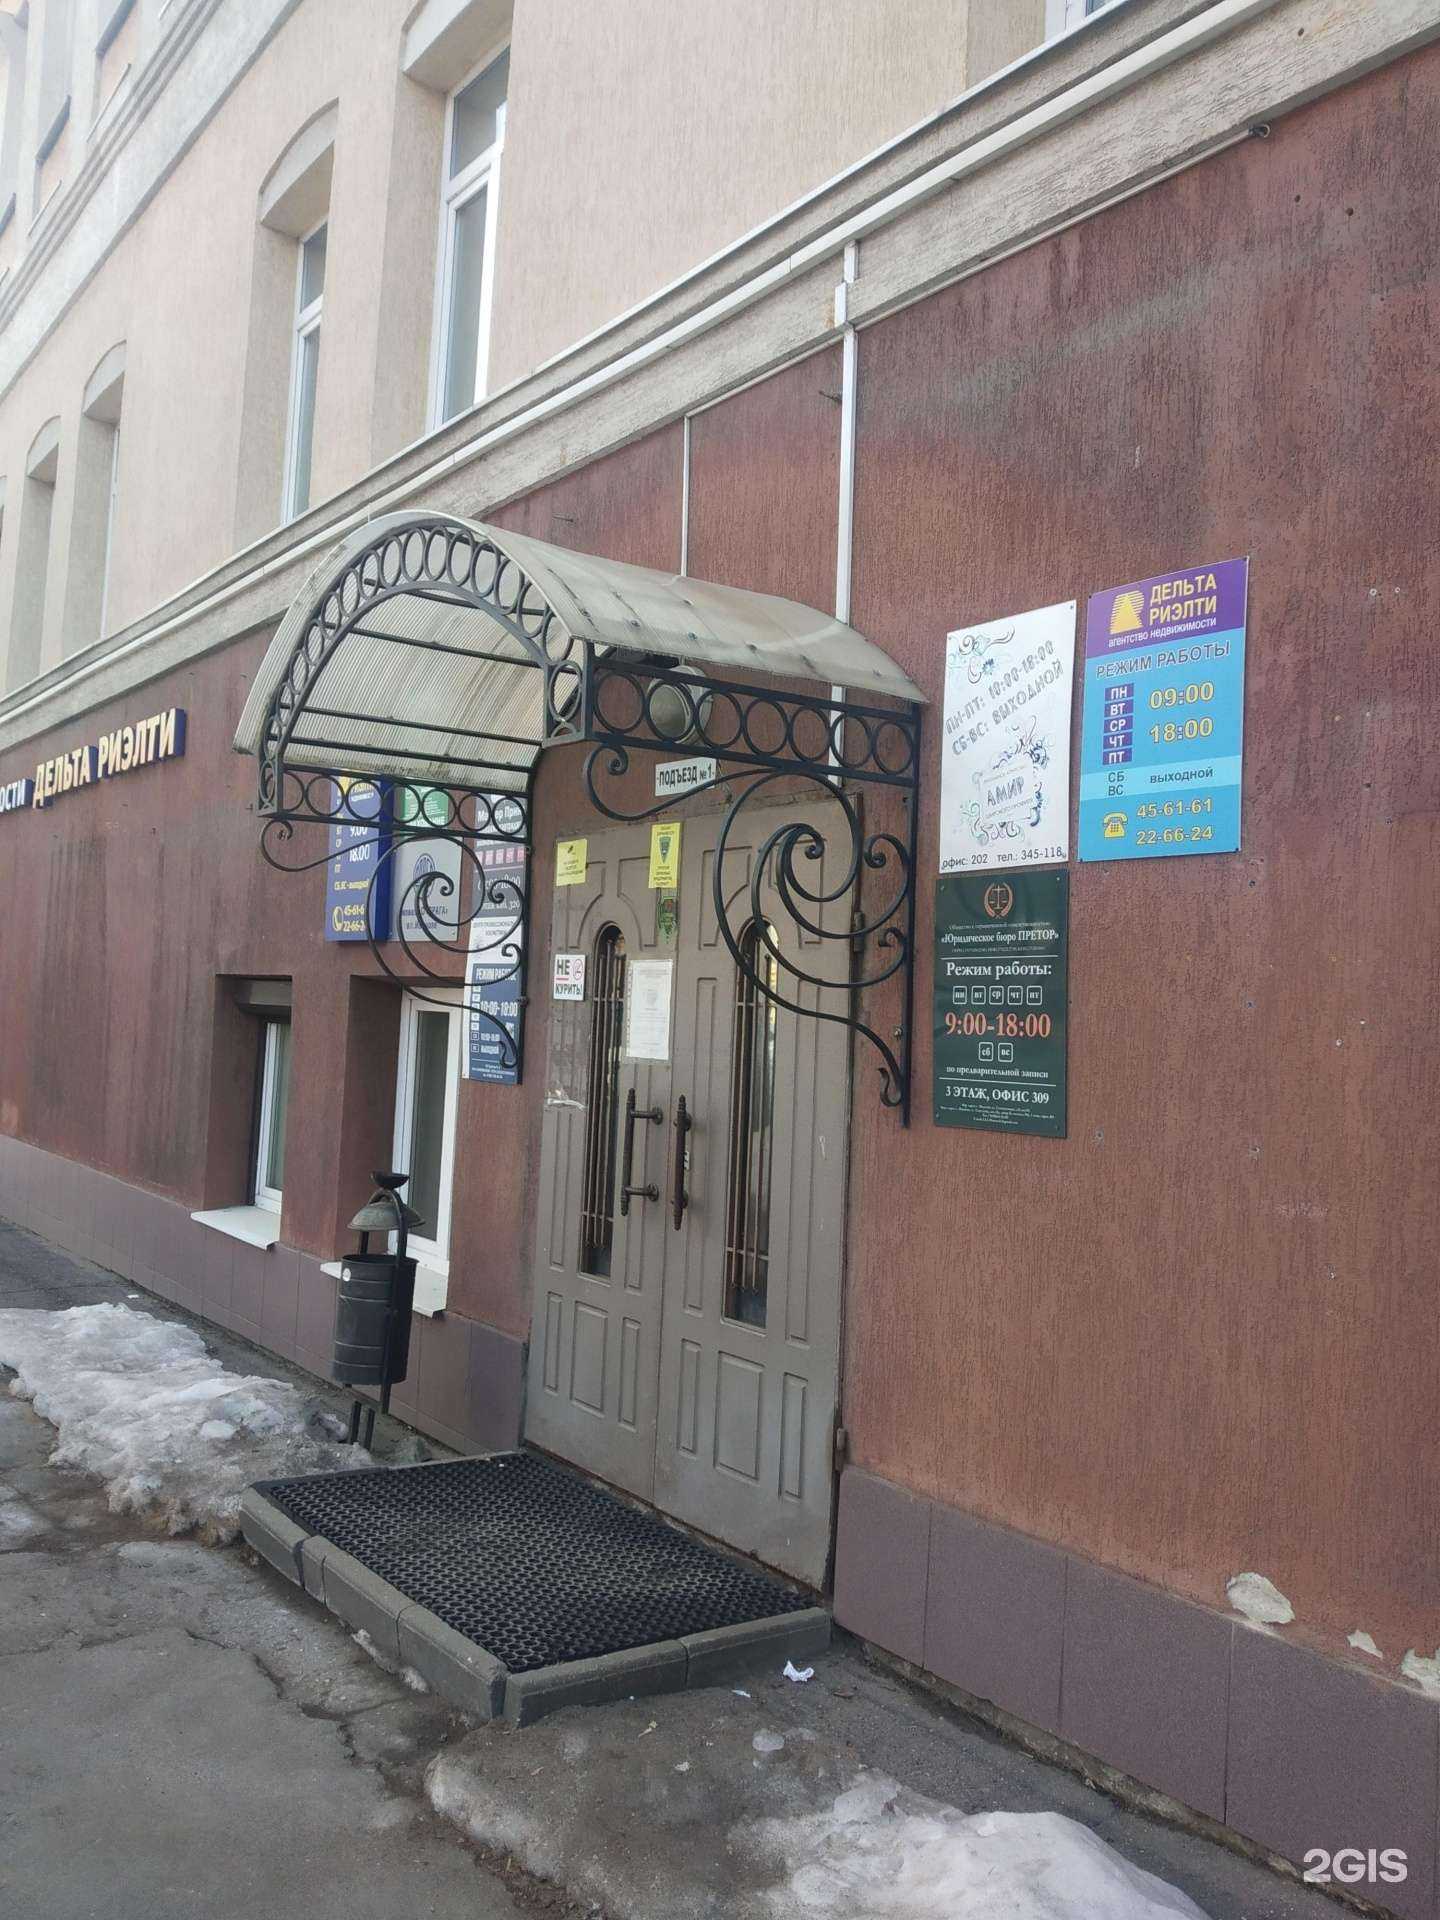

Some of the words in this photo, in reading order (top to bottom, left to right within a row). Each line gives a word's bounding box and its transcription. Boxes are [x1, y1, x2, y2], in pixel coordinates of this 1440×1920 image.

[1150, 573, 1217, 606] ДЕЛЬТА
[1149, 595, 1217, 627] РИЭЛТИ
[1096, 655, 1152, 680] РЕЖИМ
[1156, 639, 1230, 669] РАБОТЫ
[1110, 686, 1128, 699] ПН
[1150, 681, 1214, 709] 09:00
[951, 721, 990, 756] СБ-ВС:
[991, 658, 1064, 725] ВЫХОДНОЙ
[1110, 702, 1126, 715] ВТ
[1109, 718, 1127, 732] СР
[1149, 717, 1214, 744] 18:00
[1108, 735, 1125, 748] ЧТ
[32, 745, 91, 809] ДЕЛЬТА
[97, 707, 177, 779] РИЭЛТИ
[1108, 751, 1125, 764] ПТ
[659, 765, 698, 787] ПОДЪЕЗД
[1108, 771, 1125, 783] СБ
[987, 776, 1025, 807] АМИР
[1108, 785, 1124, 797] ВС
[1136, 798, 1213, 818] 45-61-61
[1136, 825, 1213, 846] 22-66-24
[971, 853, 988, 865] 202
[1021, 846, 1062, 861] 345-118
[996, 931, 1017, 945] бюро
[556, 959, 571, 976] НЕ
[946, 962, 992, 976] Режим
[995, 961, 1053, 981] работы:
[555, 983, 583, 996] КУРИТЬ!
[991, 991, 1001, 1001] ср
[945, 1012, 1052, 1038] 9:00-18:00
[981, 1047, 991, 1056] сб
[1001, 1048, 1011, 1056] вс
[946, 1065, 955, 1073] по
[956, 1067, 1020, 1077] предварительной
[1021, 1070, 1049, 1079] записи
[945, 1086, 951, 1097] 3
[953, 1086, 990, 1102] ЭТАЖ,
[992, 1089, 1030, 1103] ОФИС
[1031, 1091, 1050, 1105] 309
